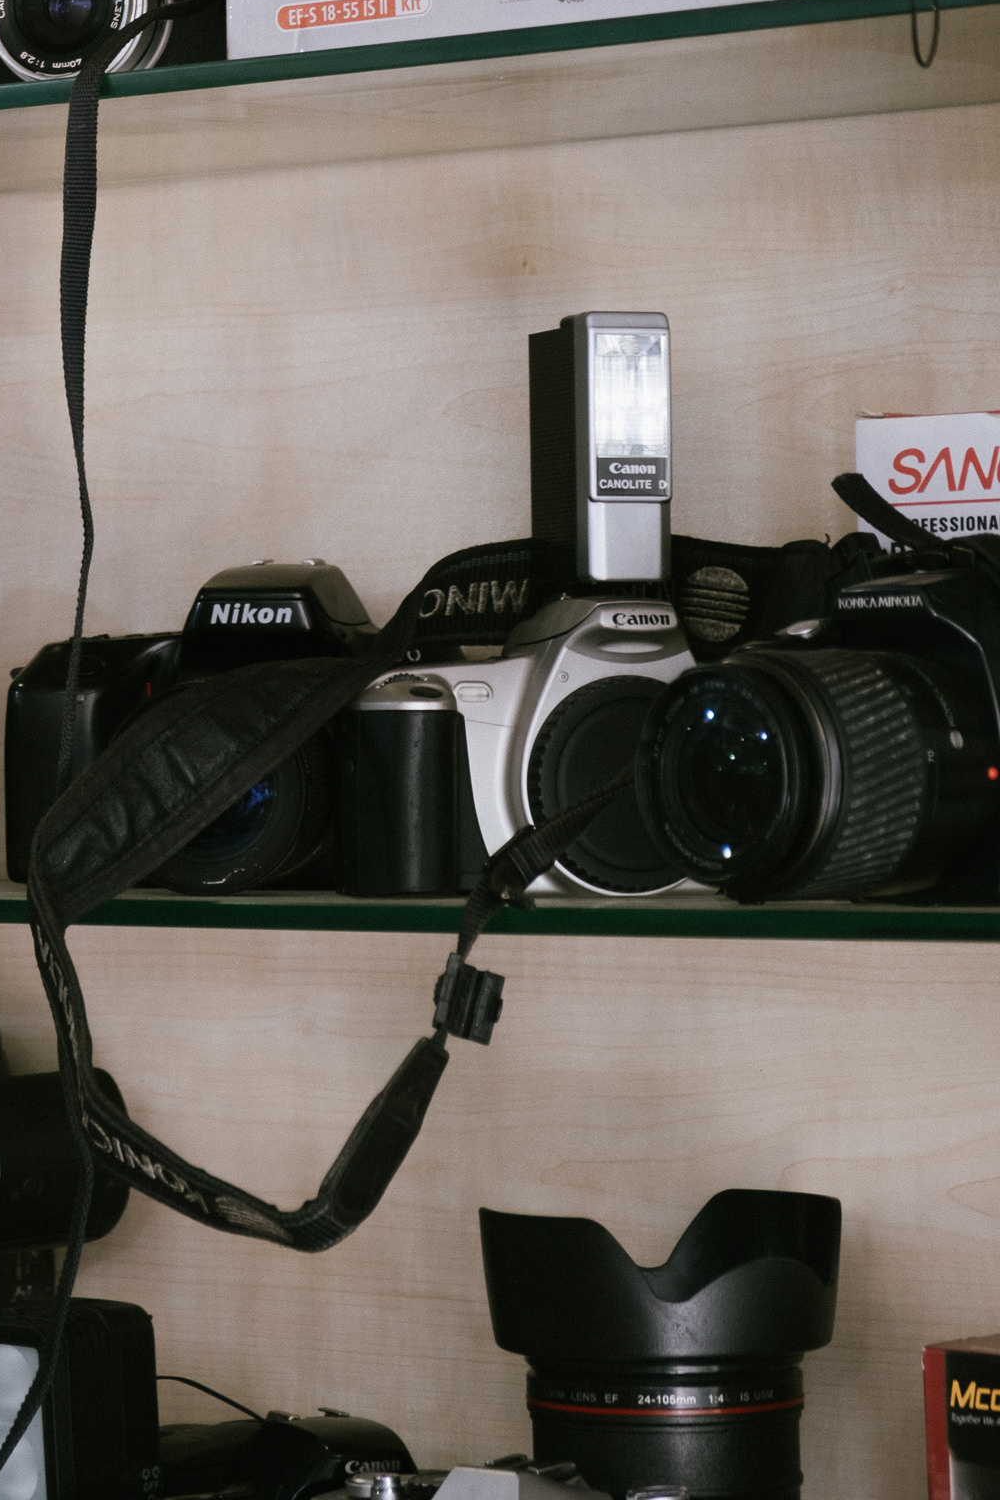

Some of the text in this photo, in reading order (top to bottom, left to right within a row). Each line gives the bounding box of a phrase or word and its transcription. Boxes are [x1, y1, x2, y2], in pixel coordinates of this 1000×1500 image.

[110, 0, 123, 29] LENS
[288, 6, 317, 26] EF-S
[321, 2, 360, 22] 18-55
[363, 0, 376, 17] IS
[20, 50, 83, 69] 40mm 1:2.8
[609, 462, 657, 475] Canon
[599, 478, 668, 490] CANOLITE D
[419, 580, 529, 618] MINO
[838, 595, 923, 610] KONICA MINOLTA
[210, 603, 293, 625] Nikon
[612, 612, 671, 628] Canon
[571, 1392, 597, 1402] LENS
[604, 1393, 618, 1404] EF
[638, 1394, 697, 1405] 24-105mm
[740, 1390, 750, 1401] IS
[344, 1458, 401, 1475] Canon
[141, 1481, 160, 1491] OFF
